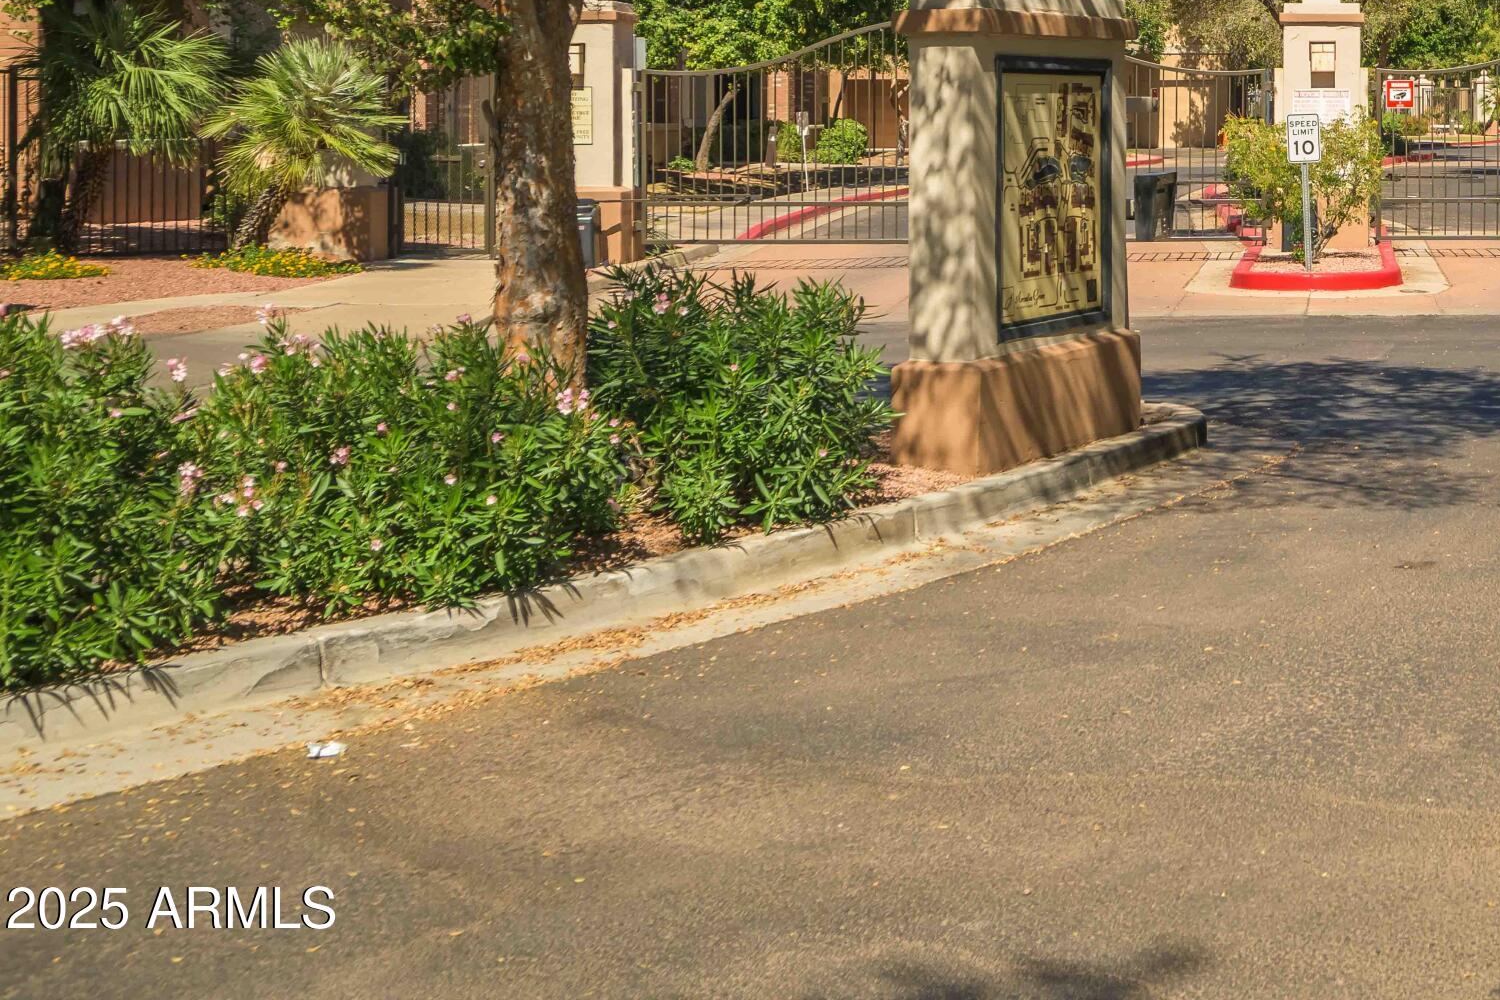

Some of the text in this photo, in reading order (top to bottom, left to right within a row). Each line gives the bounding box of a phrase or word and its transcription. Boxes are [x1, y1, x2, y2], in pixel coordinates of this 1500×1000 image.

[1289, 120, 1318, 128] SPEED
[1292, 128, 1314, 136] LIMIT
[1293, 140, 1315, 156] 10
